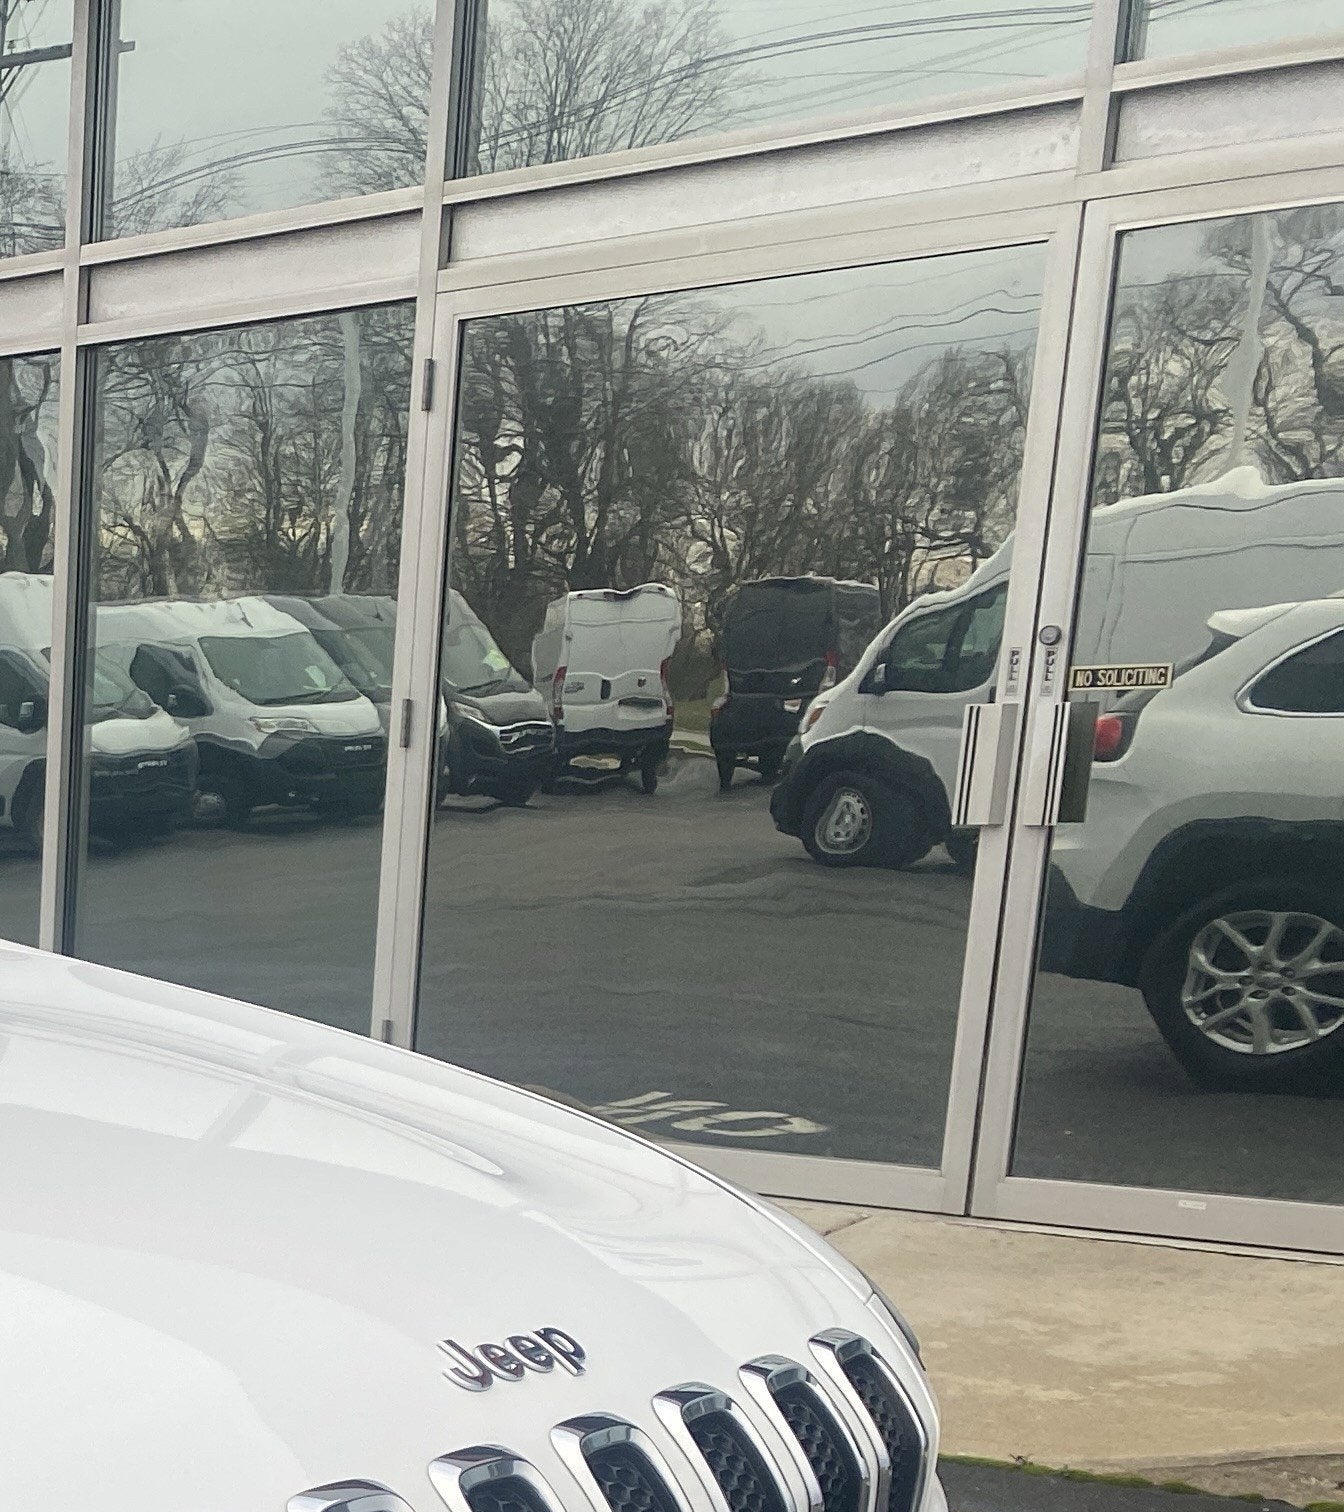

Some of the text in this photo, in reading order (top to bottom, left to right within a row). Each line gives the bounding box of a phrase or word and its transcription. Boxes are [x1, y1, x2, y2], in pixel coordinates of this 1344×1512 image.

[1044, 649, 1056, 682] PULL
[1075, 667, 1166, 687] NO SOLICITING
[437, 1326, 586, 1392] Jeep
